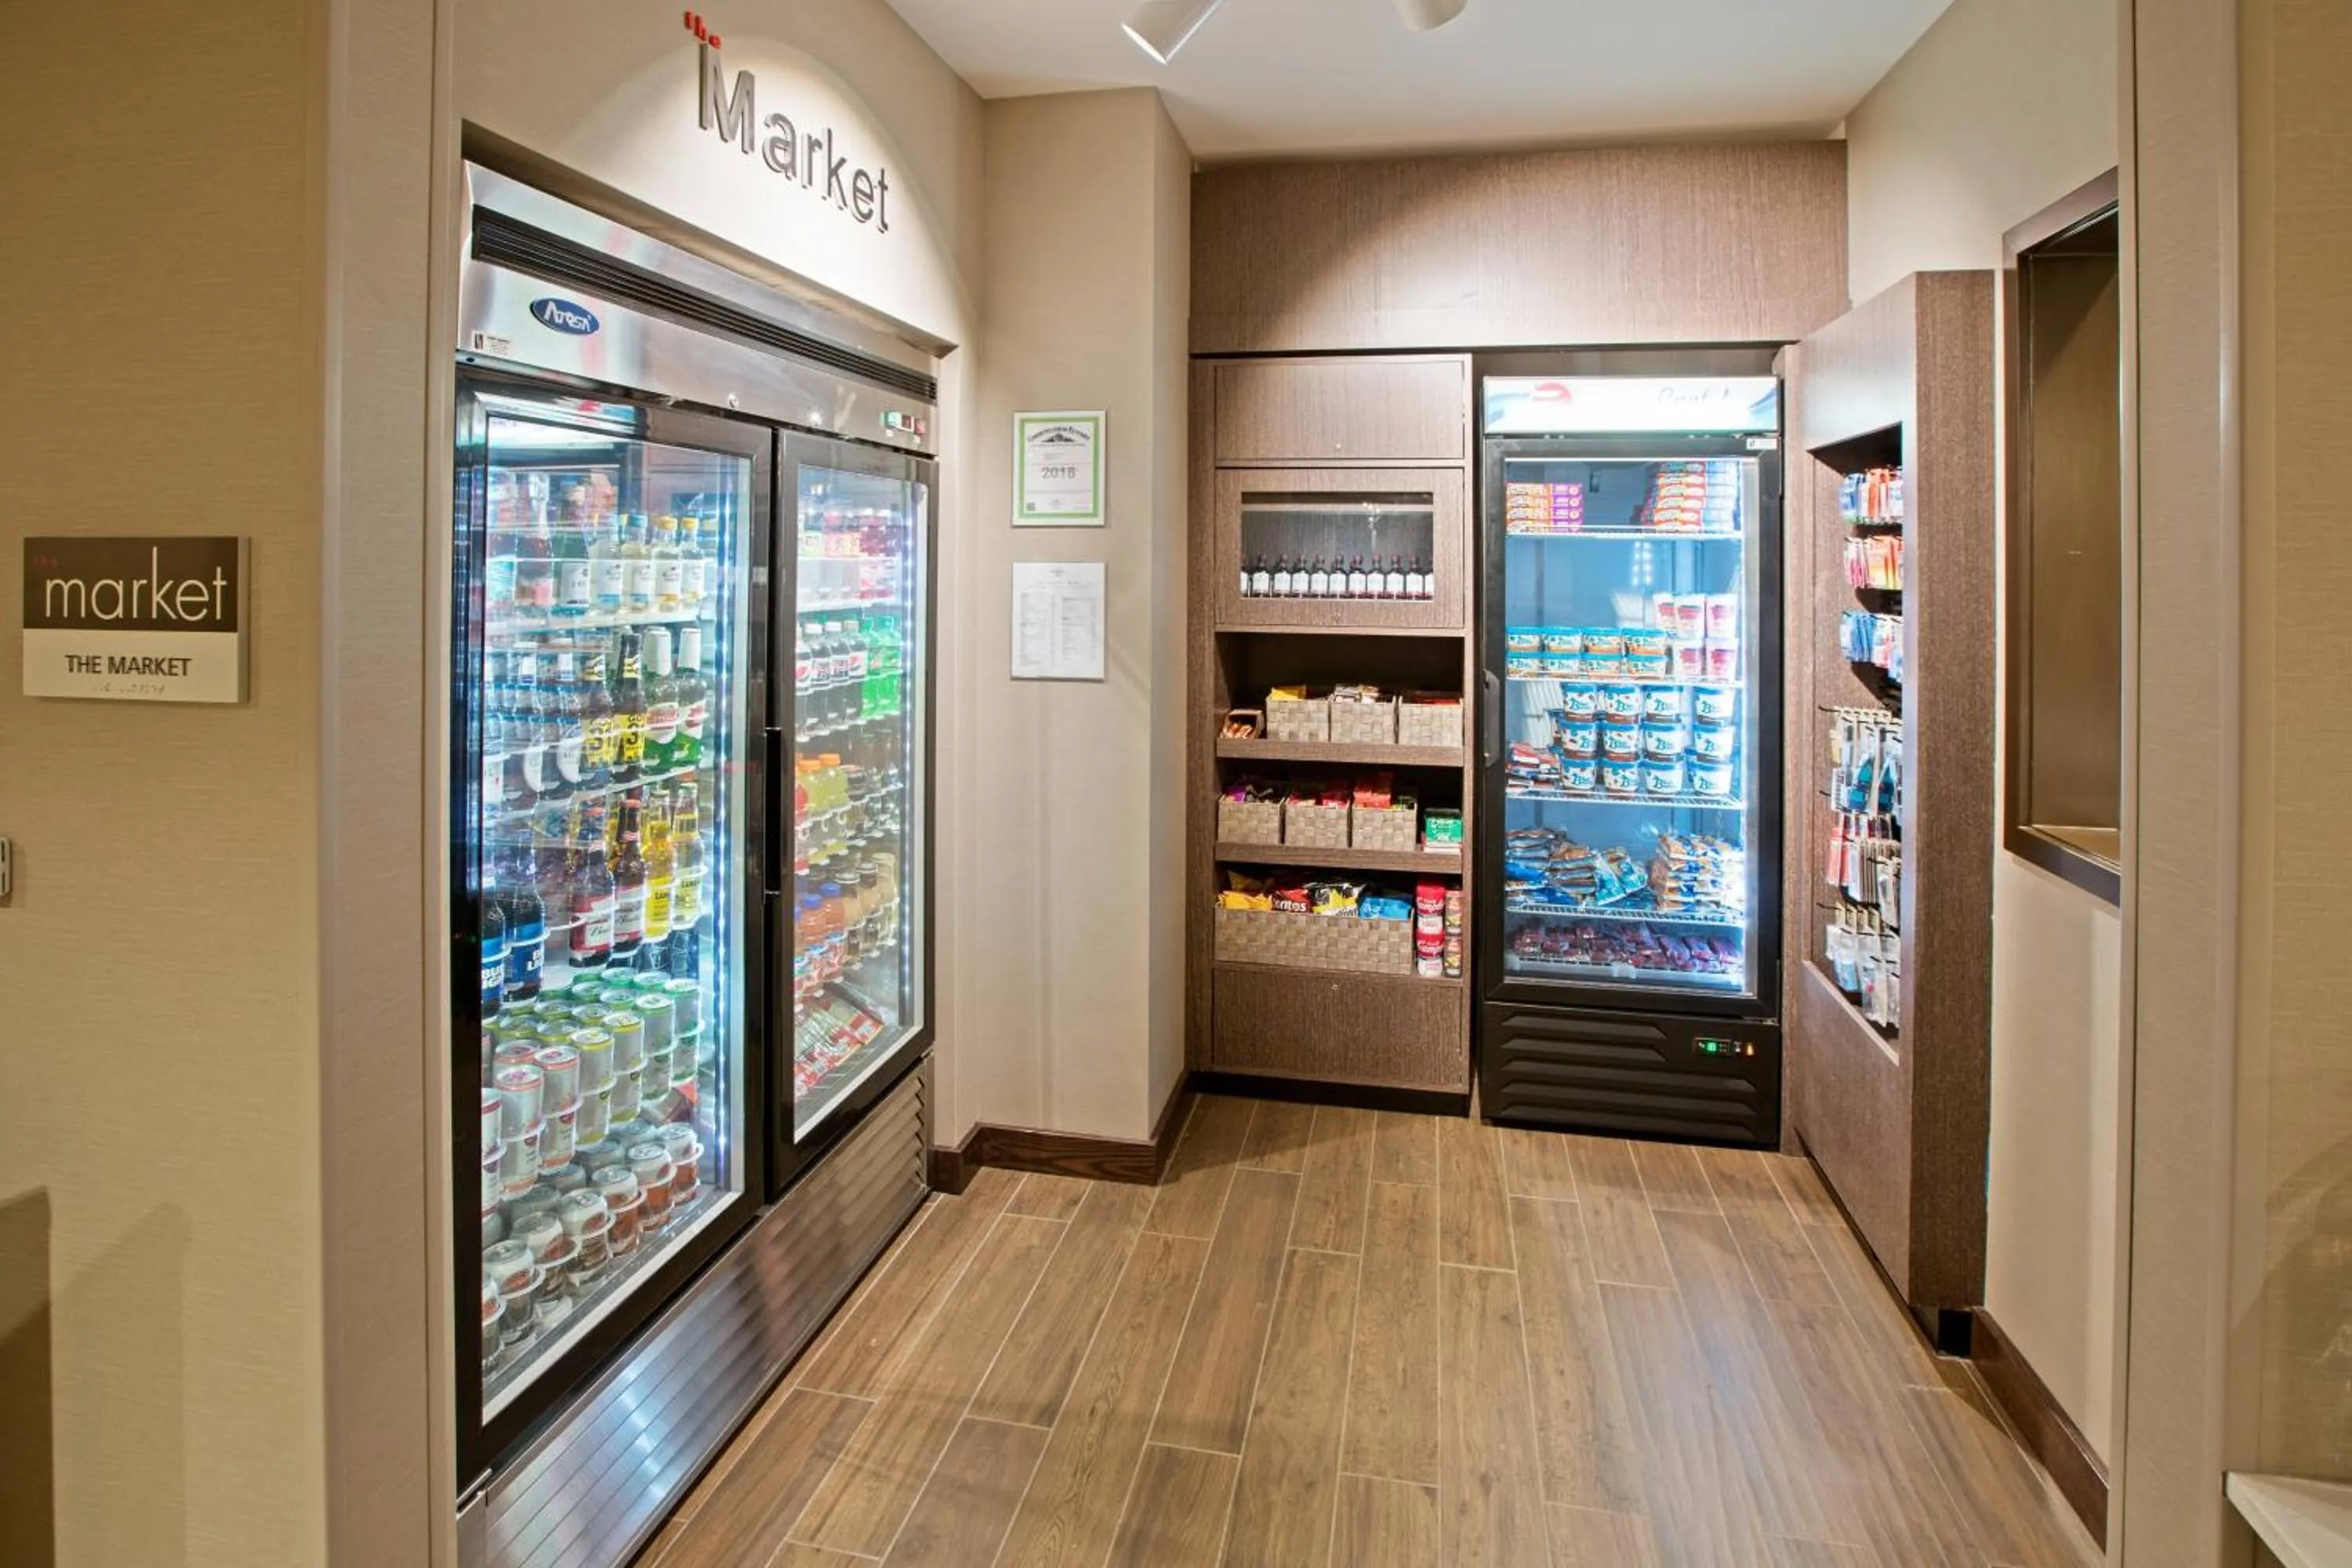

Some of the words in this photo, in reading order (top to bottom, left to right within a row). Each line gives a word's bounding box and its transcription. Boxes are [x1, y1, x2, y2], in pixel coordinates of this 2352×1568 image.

[699, 44, 888, 234] Market
[45, 546, 227, 621] market
[64, 655, 102, 673] THE
[107, 656, 193, 677] MARKET
